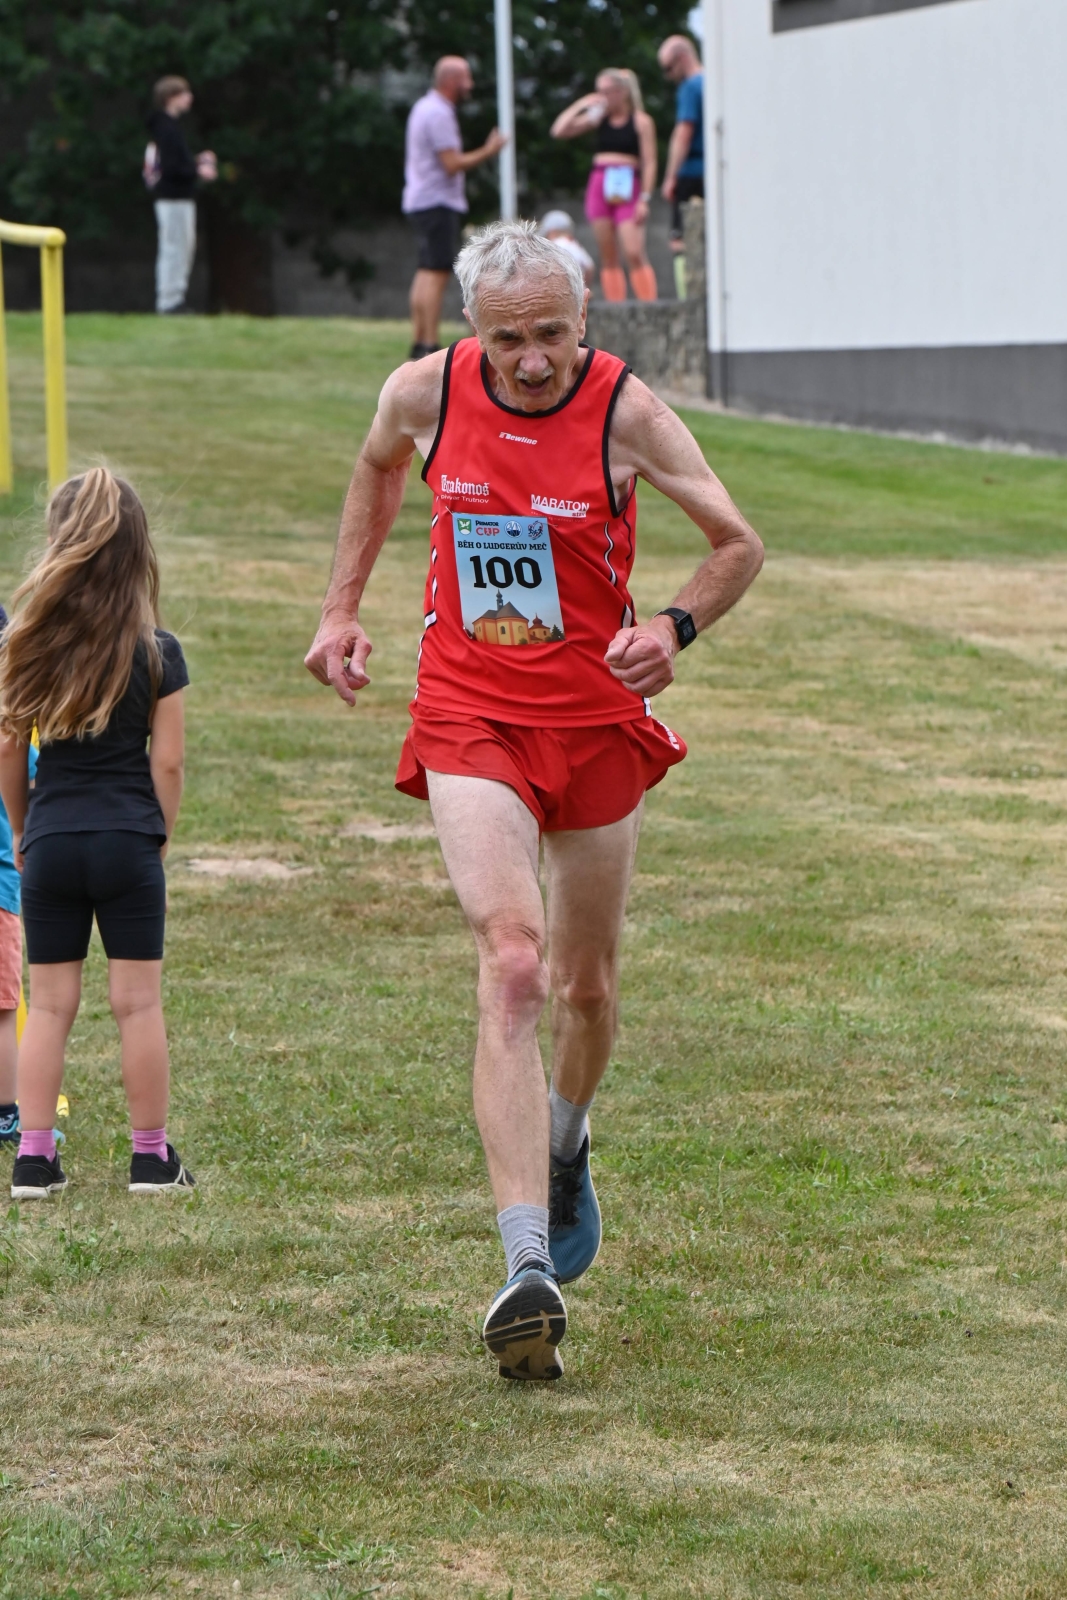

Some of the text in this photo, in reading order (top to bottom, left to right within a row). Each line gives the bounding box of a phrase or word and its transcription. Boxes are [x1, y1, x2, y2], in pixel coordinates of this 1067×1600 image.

[461, 495, 489, 504] Trutnov
[531, 494, 590, 511] MARATON
[475, 527, 500, 536] CUP
[457, 540, 474, 549] BĚH
[483, 541, 527, 550] LUDGERŮV
[529, 542, 547, 551] MEČ
[470, 555, 542, 589] 100
